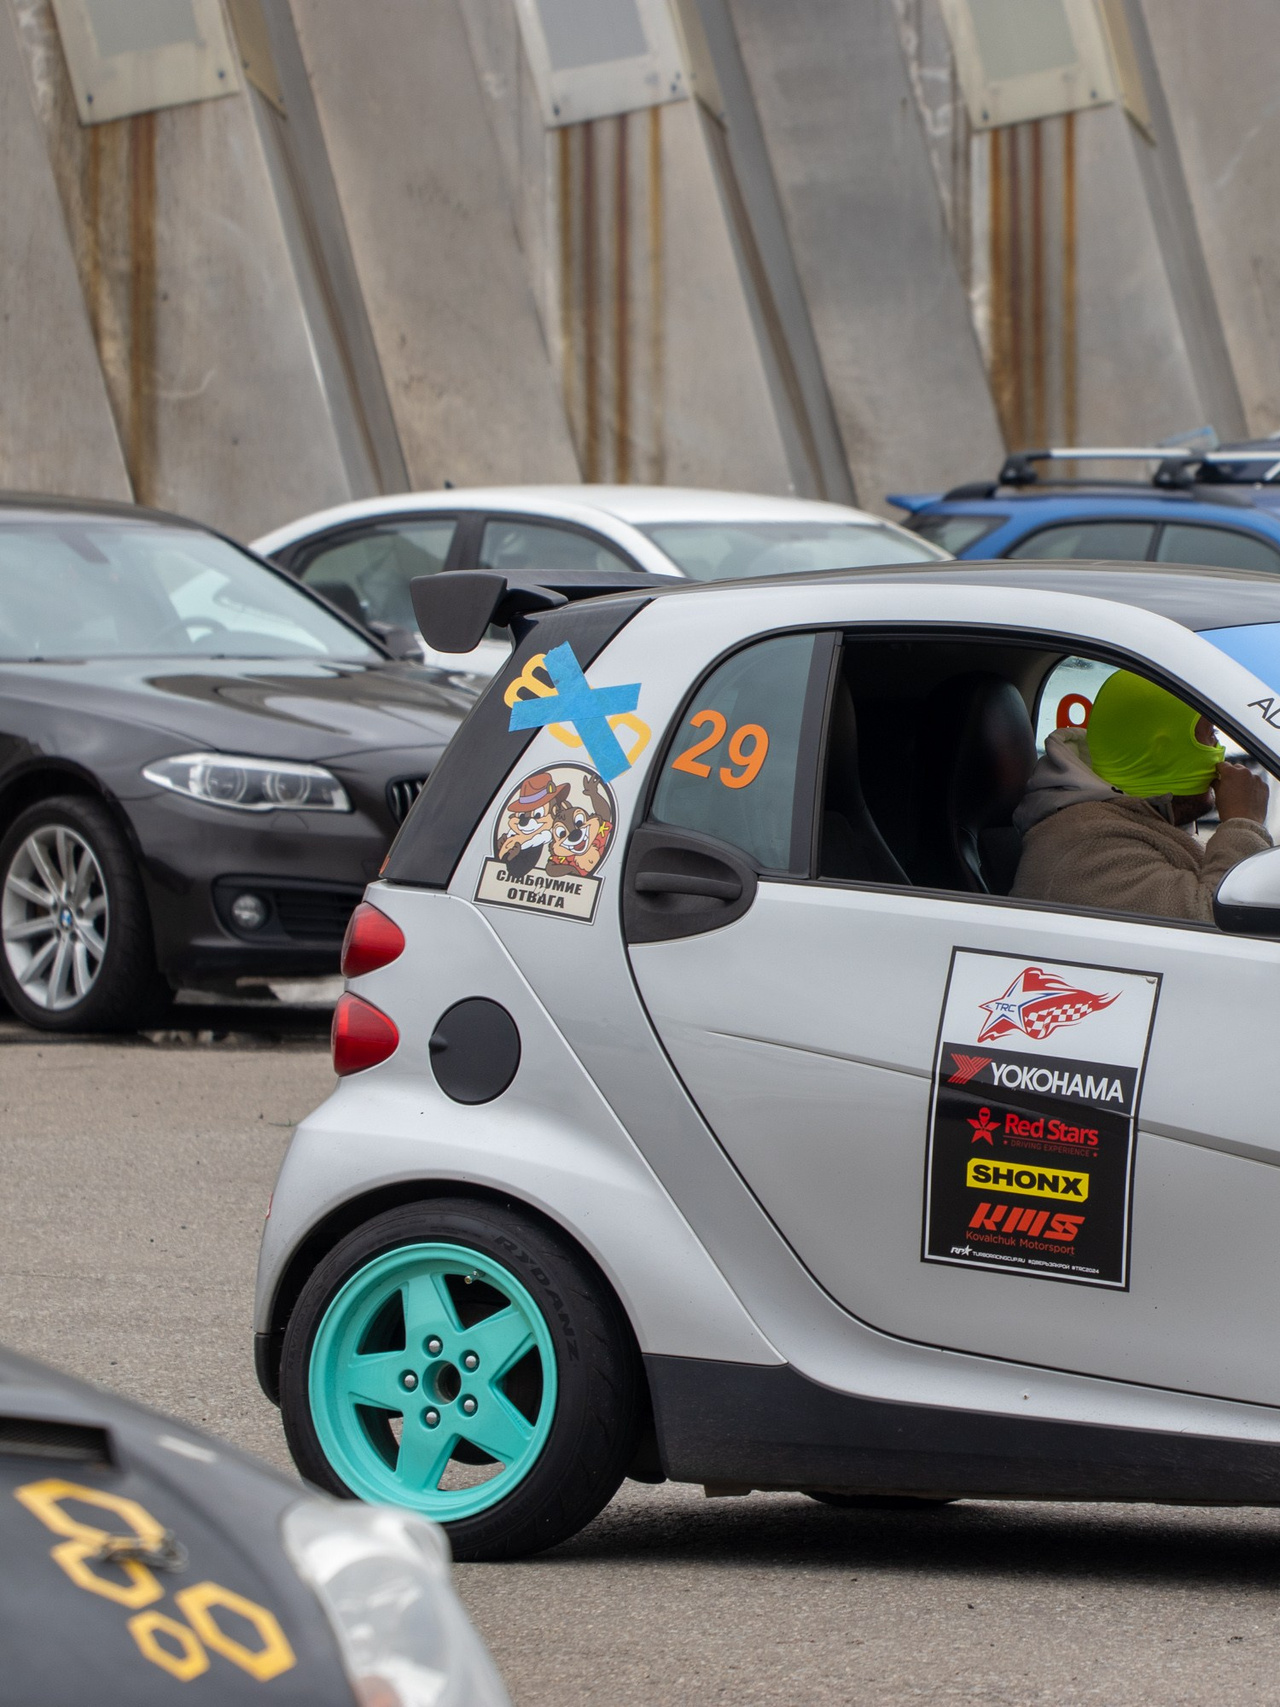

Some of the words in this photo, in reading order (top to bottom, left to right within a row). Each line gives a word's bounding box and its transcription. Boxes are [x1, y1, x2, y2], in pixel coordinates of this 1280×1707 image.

[671, 709, 769, 789] 29
[507, 887, 564, 908] ОТВАГА
[995, 1002, 1017, 1013] TRC
[991, 1062, 1124, 1103] YOKOHAMA
[1005, 1113, 1044, 1138] Red
[1047, 1119, 1099, 1146] Stars
[1011, 1139, 1041, 1150] DRIVING
[1043, 1145, 1090, 1157] EXPERIENCE
[972, 1164, 1083, 1197] SHONX
[966, 1230, 1016, 1247] Kovalchuk
[1019, 1238, 1075, 1255] Motorsport
[494, 1235, 579, 1362] RYDANZ
